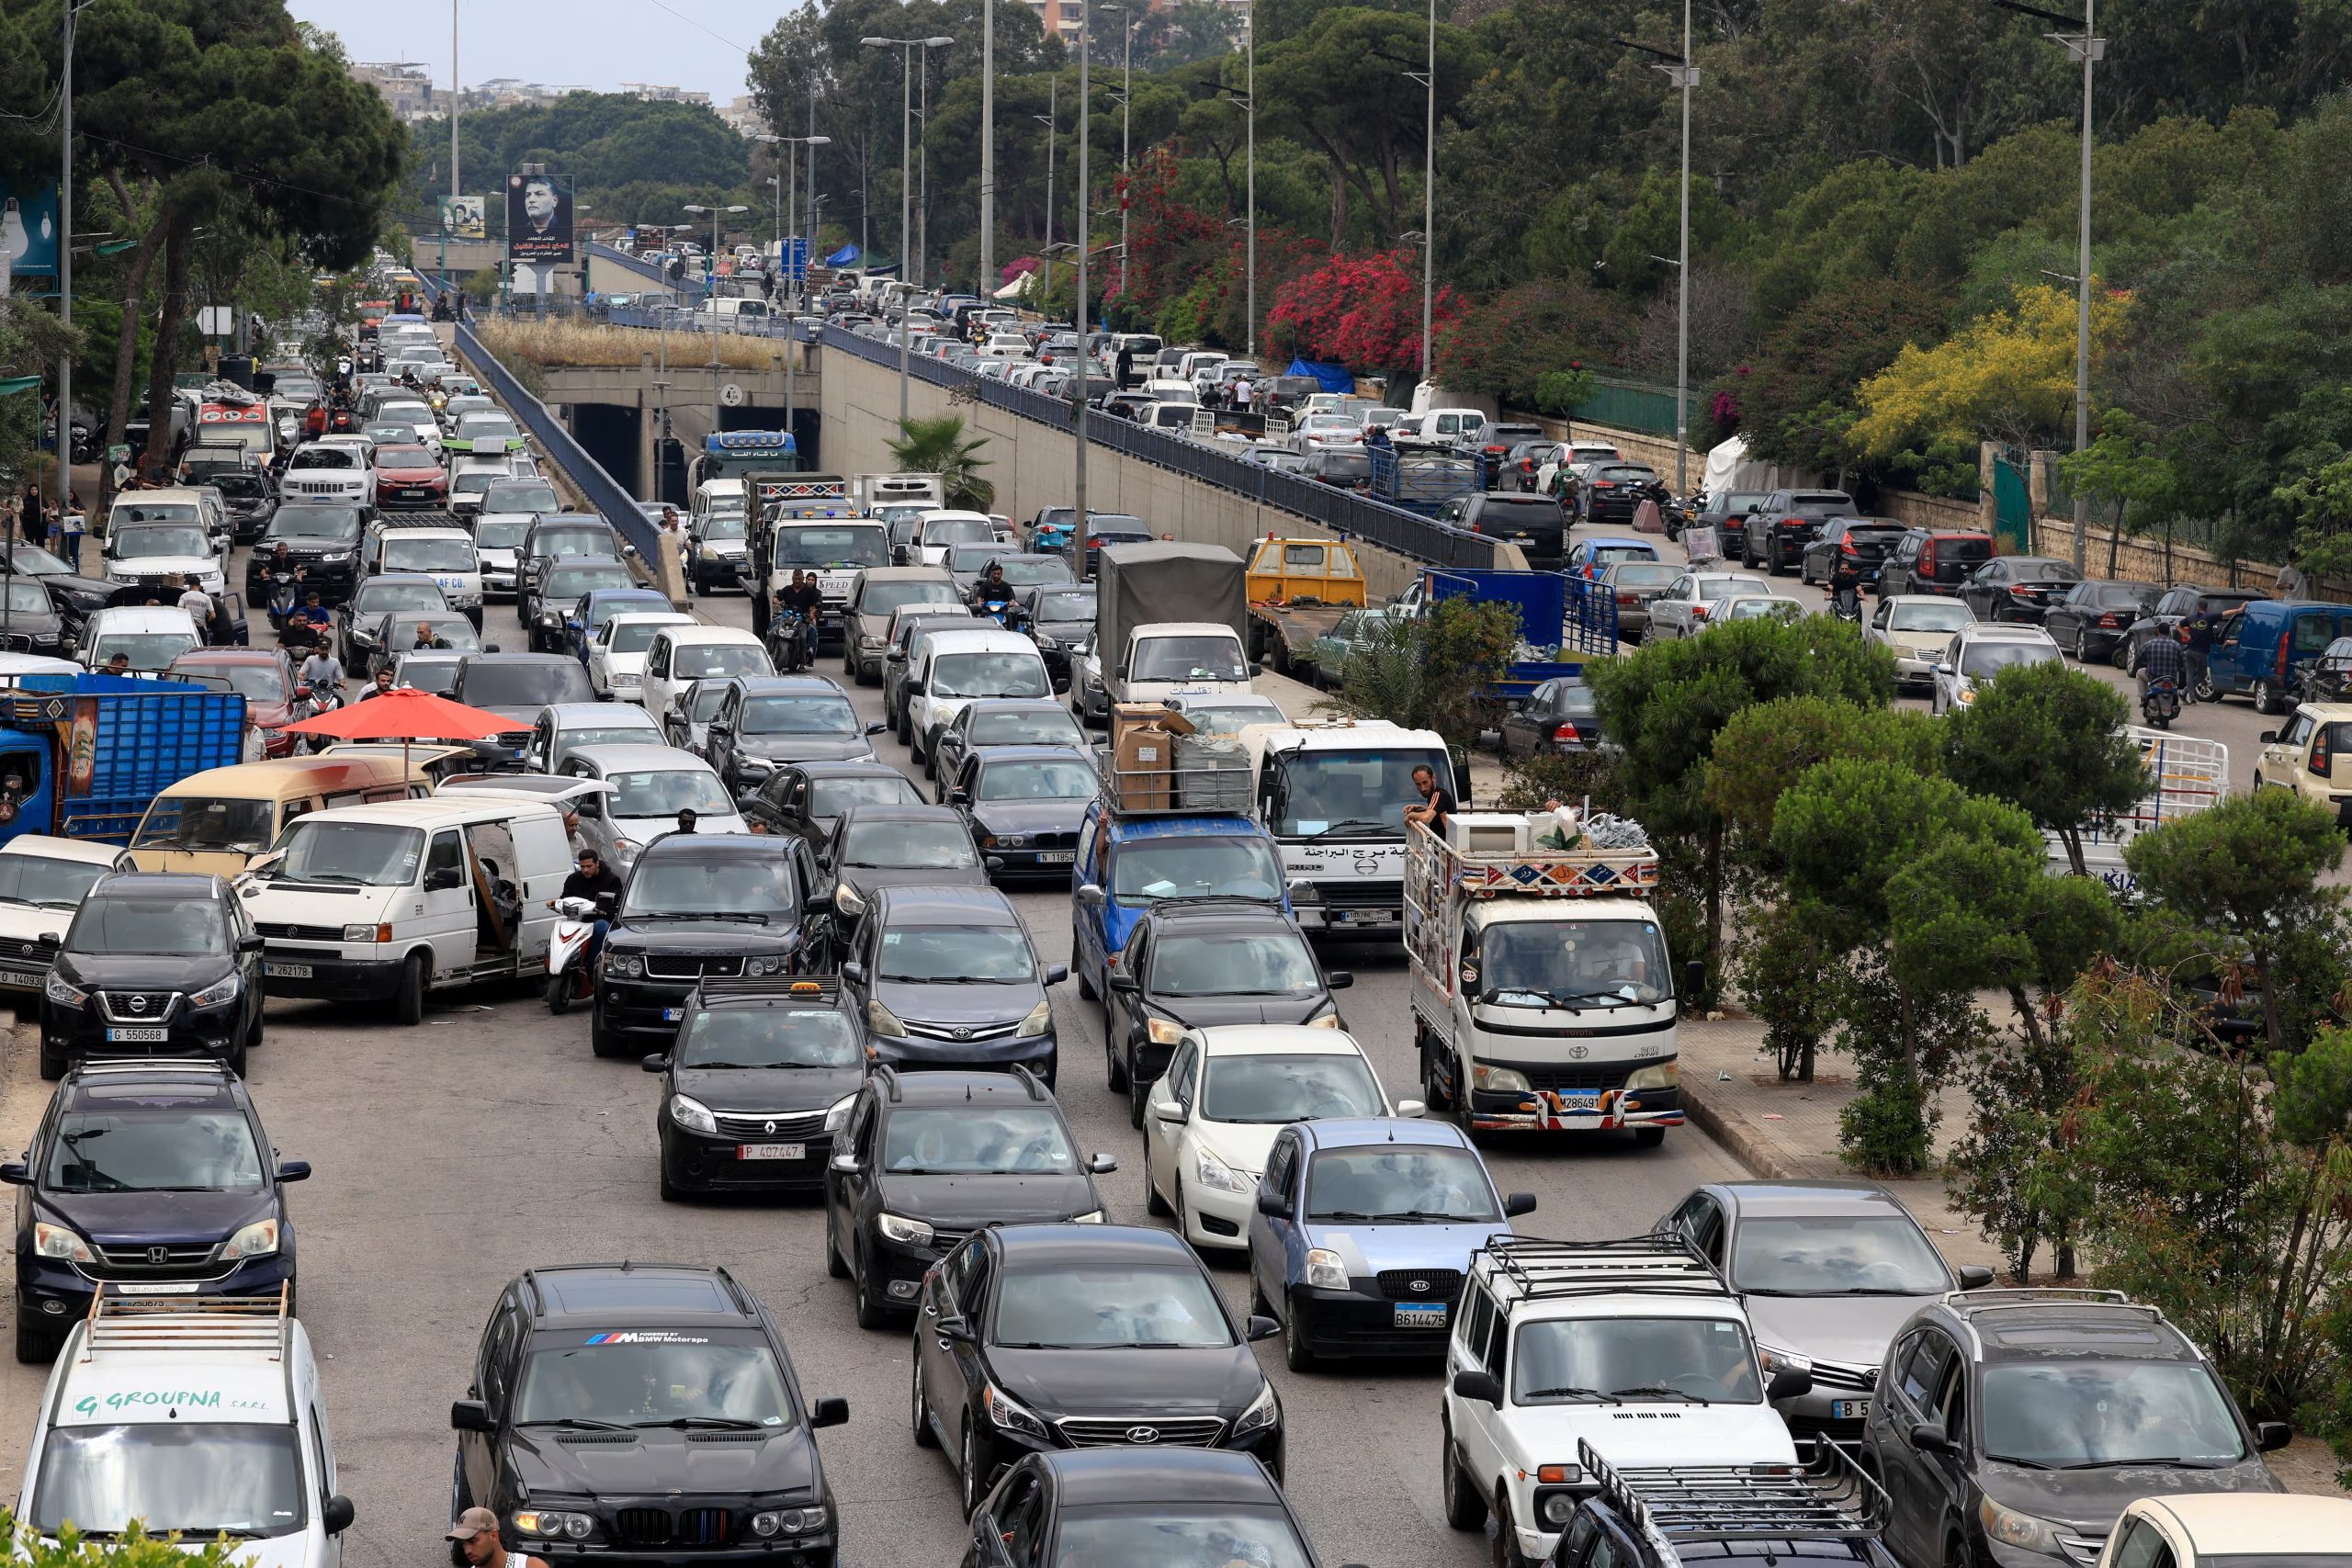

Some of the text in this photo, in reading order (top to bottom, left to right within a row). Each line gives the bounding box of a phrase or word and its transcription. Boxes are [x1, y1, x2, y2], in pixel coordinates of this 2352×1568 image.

[726, 390, 731, 400] 4
[451, 578, 466, 589] CO.
[1170, 686, 1212, 695] نقليات
[1304, 848, 1349, 859] البراجنة
[1352, 849, 1386, 859] برج
[2104, 872, 2138, 892] KIA
[277, 966, 308, 976] 262178
[115, 1030, 162, 1040] G 550568
[746, 1146, 798, 1157] P 407447
[1396, 1314, 1445, 1326] B614475
[106, 1391, 221, 1411] GROUPNA
[229, 1400, 270, 1411] S.A.R.L.
[1845, 1402, 1853, 1416] B
